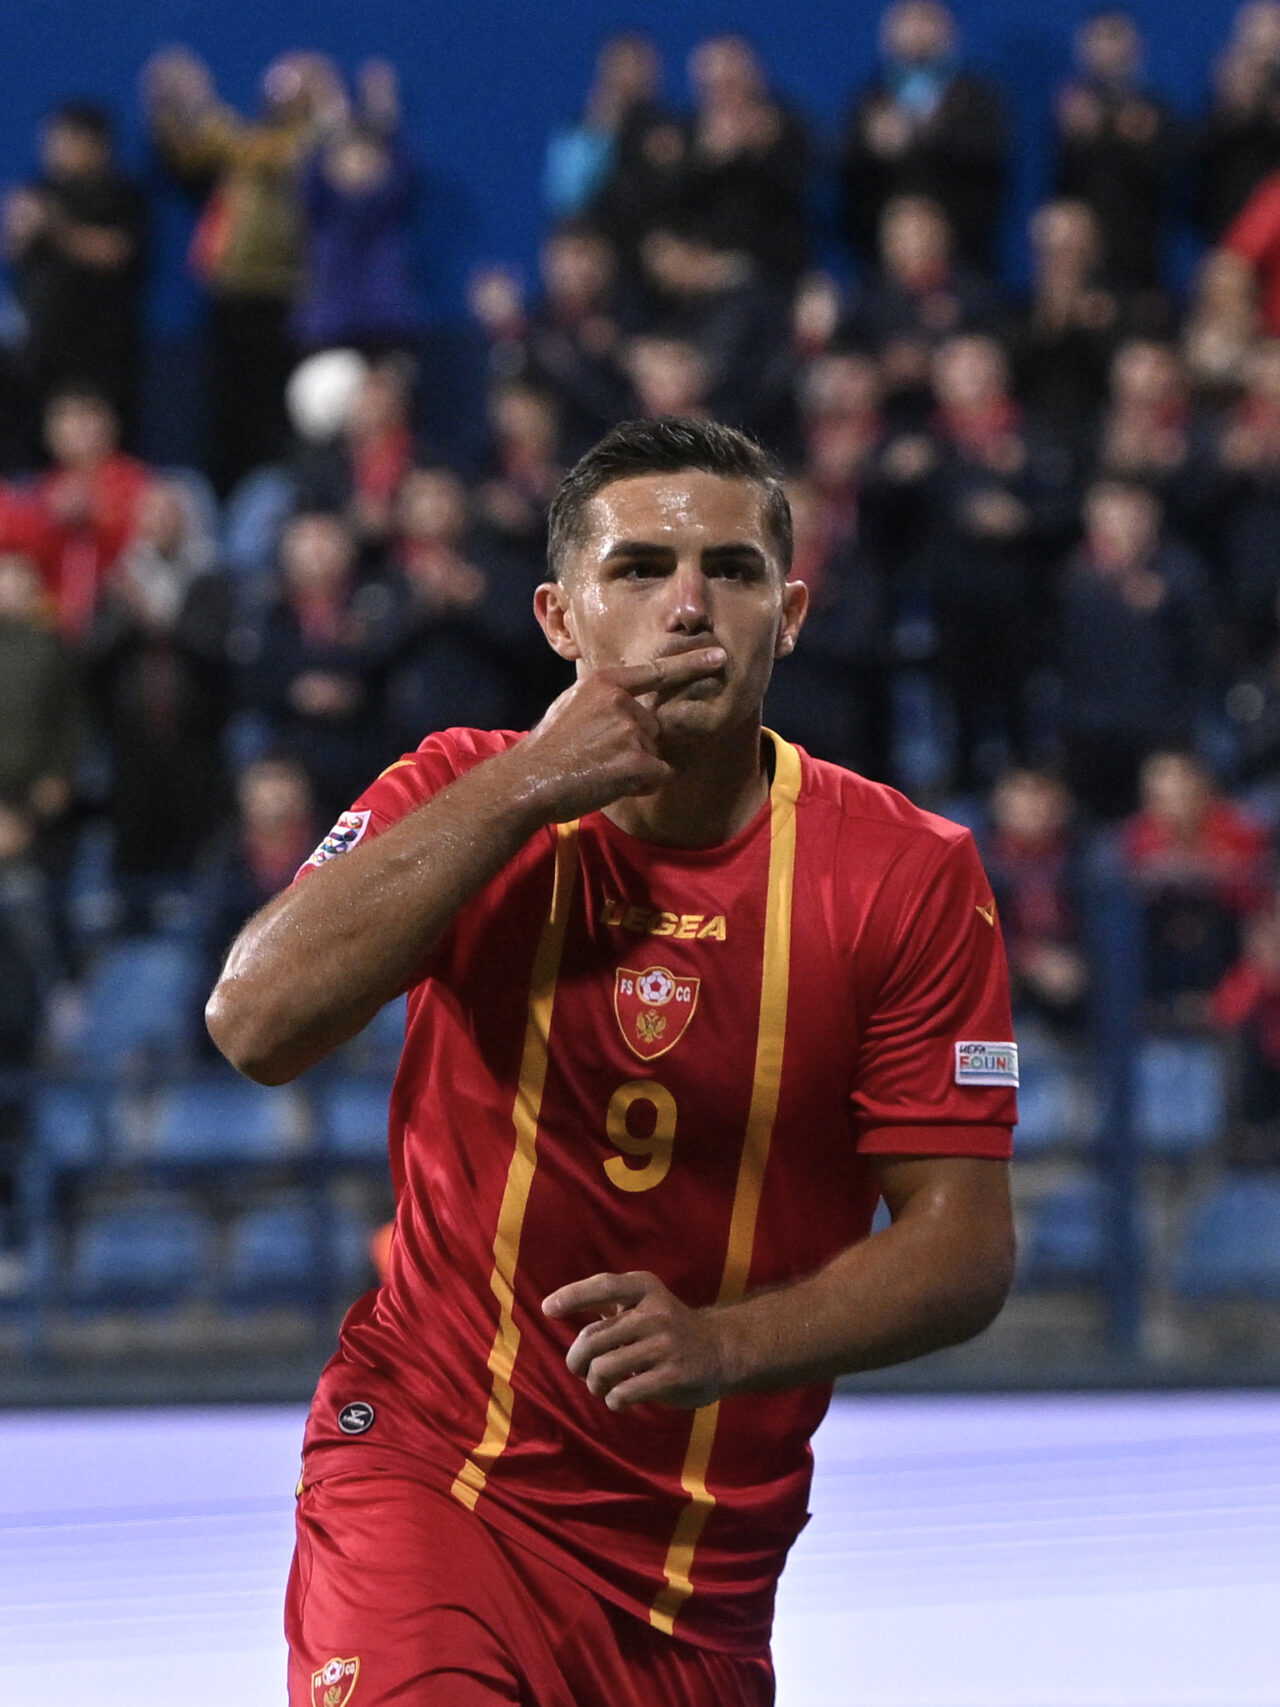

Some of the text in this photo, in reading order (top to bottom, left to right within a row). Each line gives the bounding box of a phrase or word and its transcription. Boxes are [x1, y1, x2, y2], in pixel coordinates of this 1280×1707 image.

[599, 899, 728, 941] LEGEA
[620, 978, 691, 1003] FS CG
[959, 1044, 985, 1054] UEFA
[603, 1079, 677, 1192] 9
